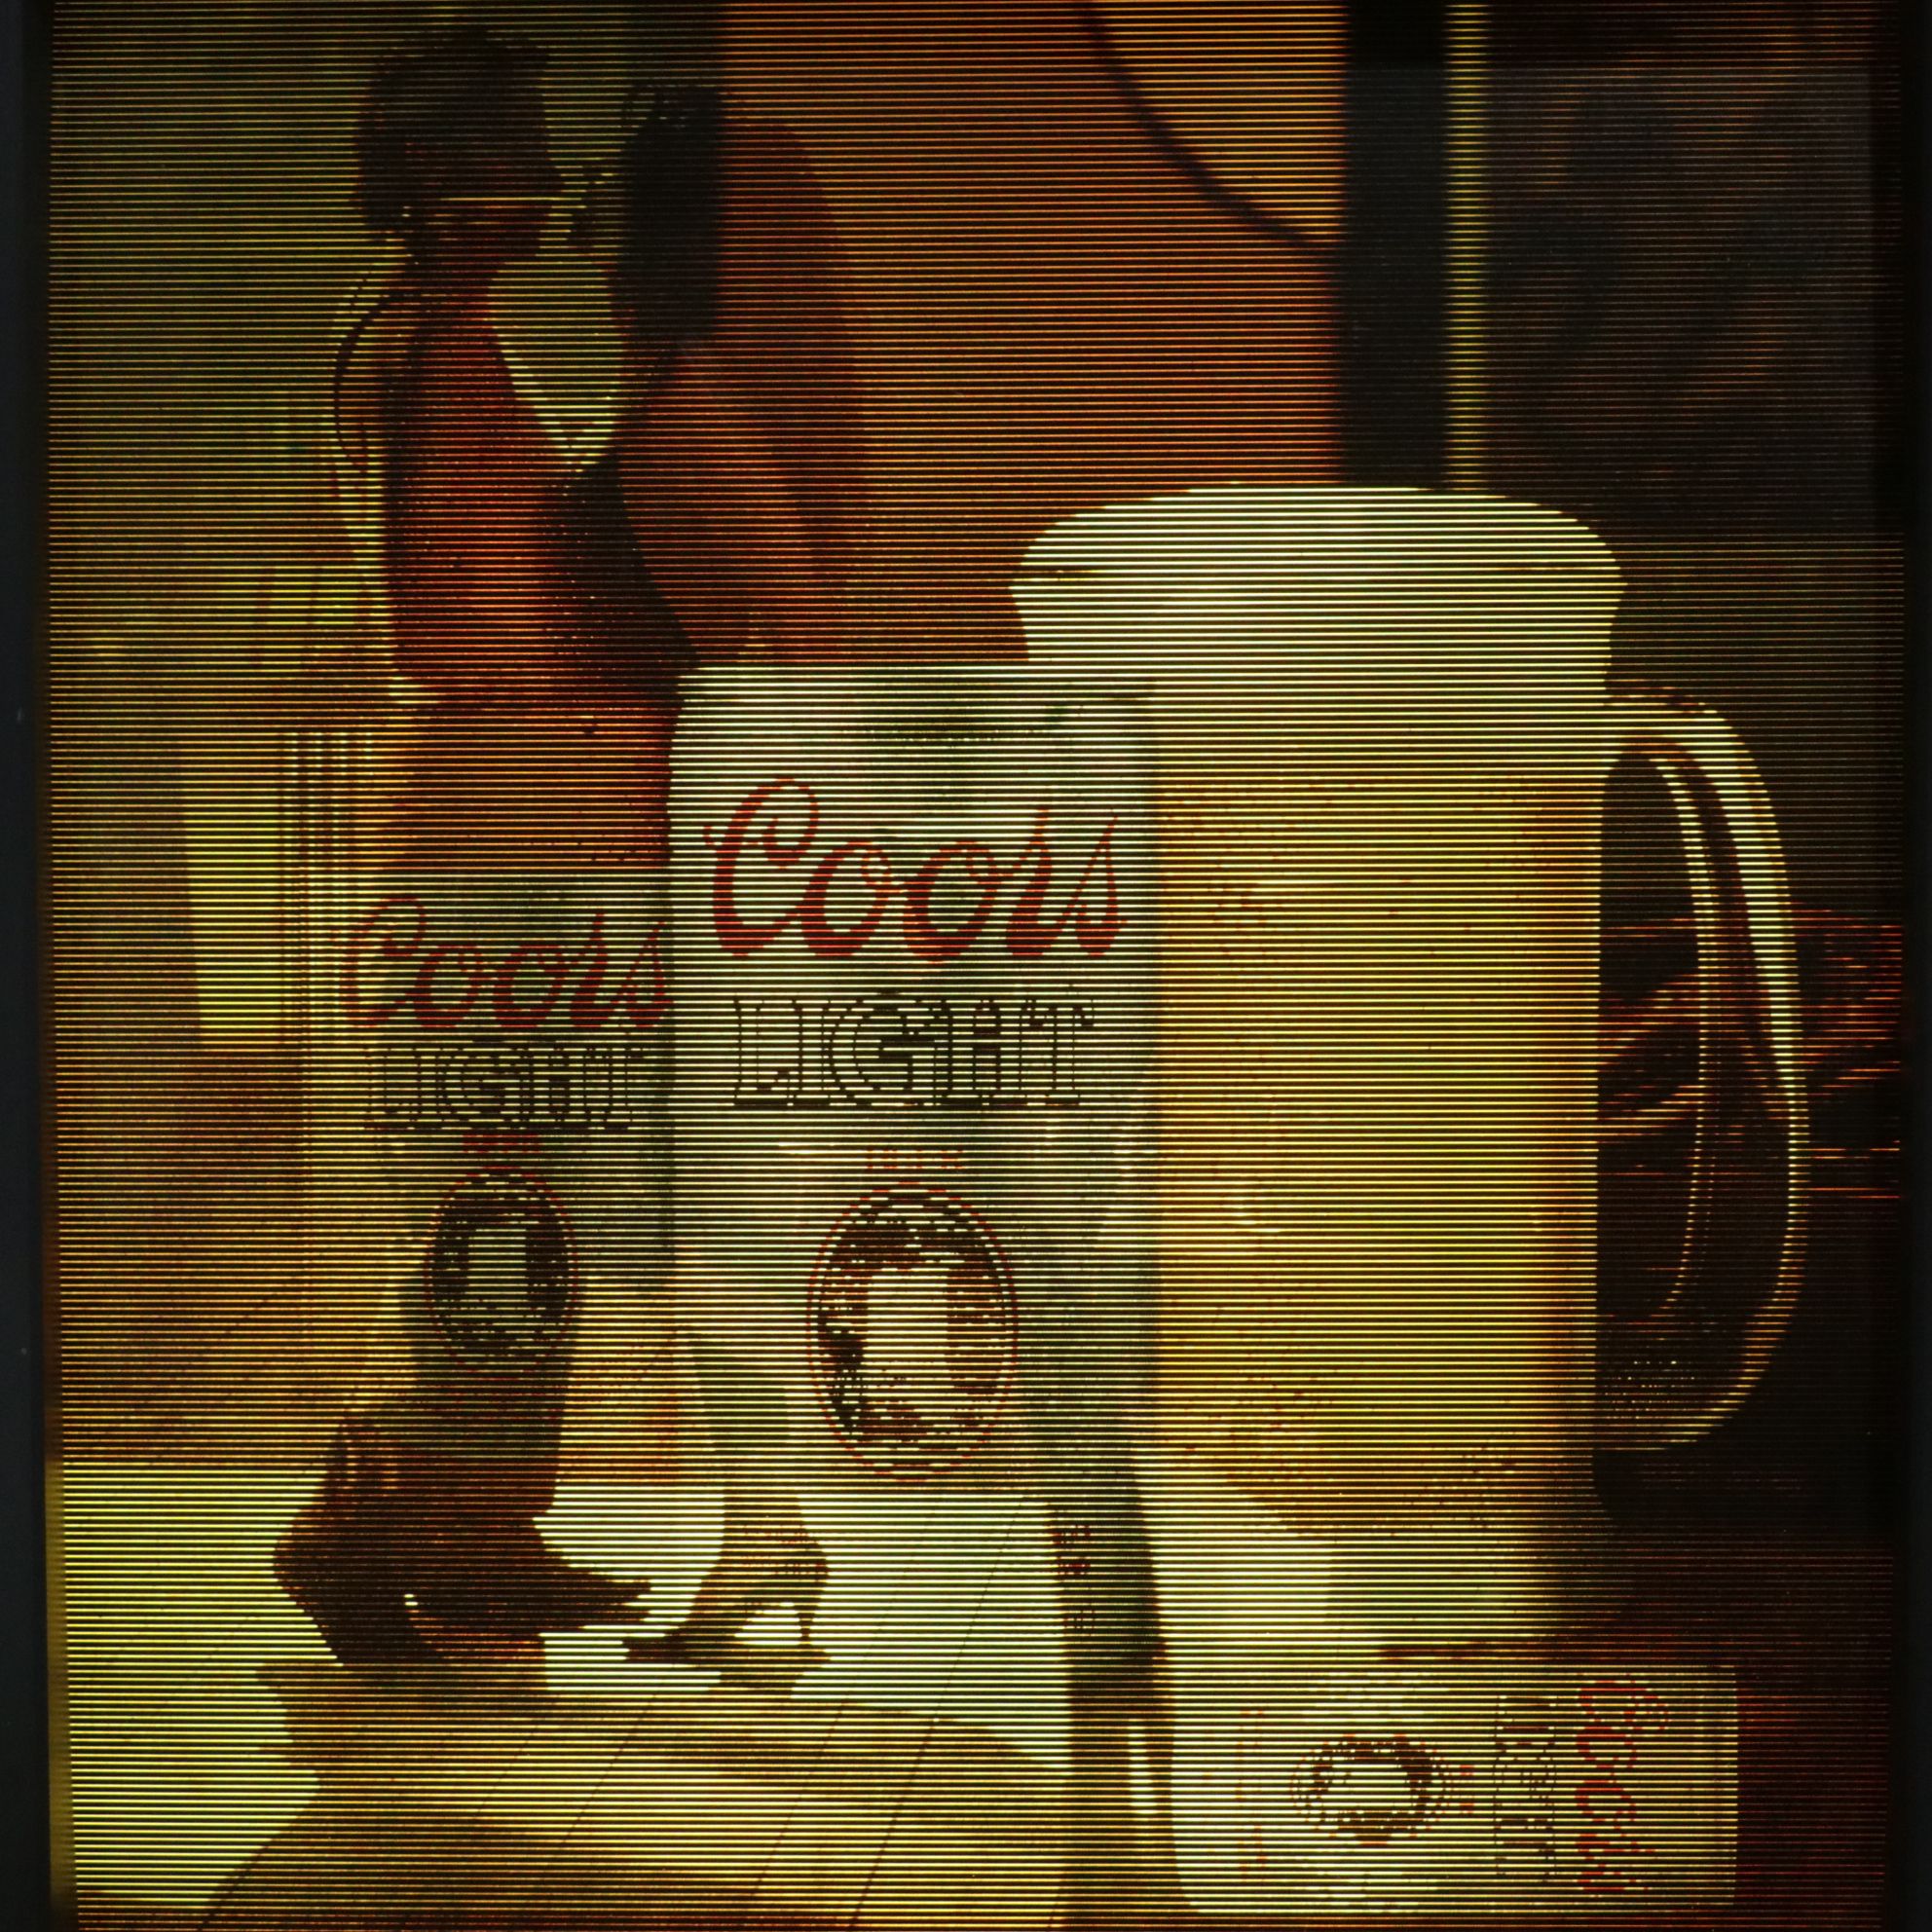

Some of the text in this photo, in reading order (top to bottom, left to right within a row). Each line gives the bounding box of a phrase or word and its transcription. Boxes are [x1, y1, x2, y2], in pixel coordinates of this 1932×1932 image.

[704, 776, 1128, 961] Coors
[329, 893, 672, 1028] Coors
[361, 1036, 646, 1131] LIGHT
[732, 990, 1096, 1108] LIGHT
